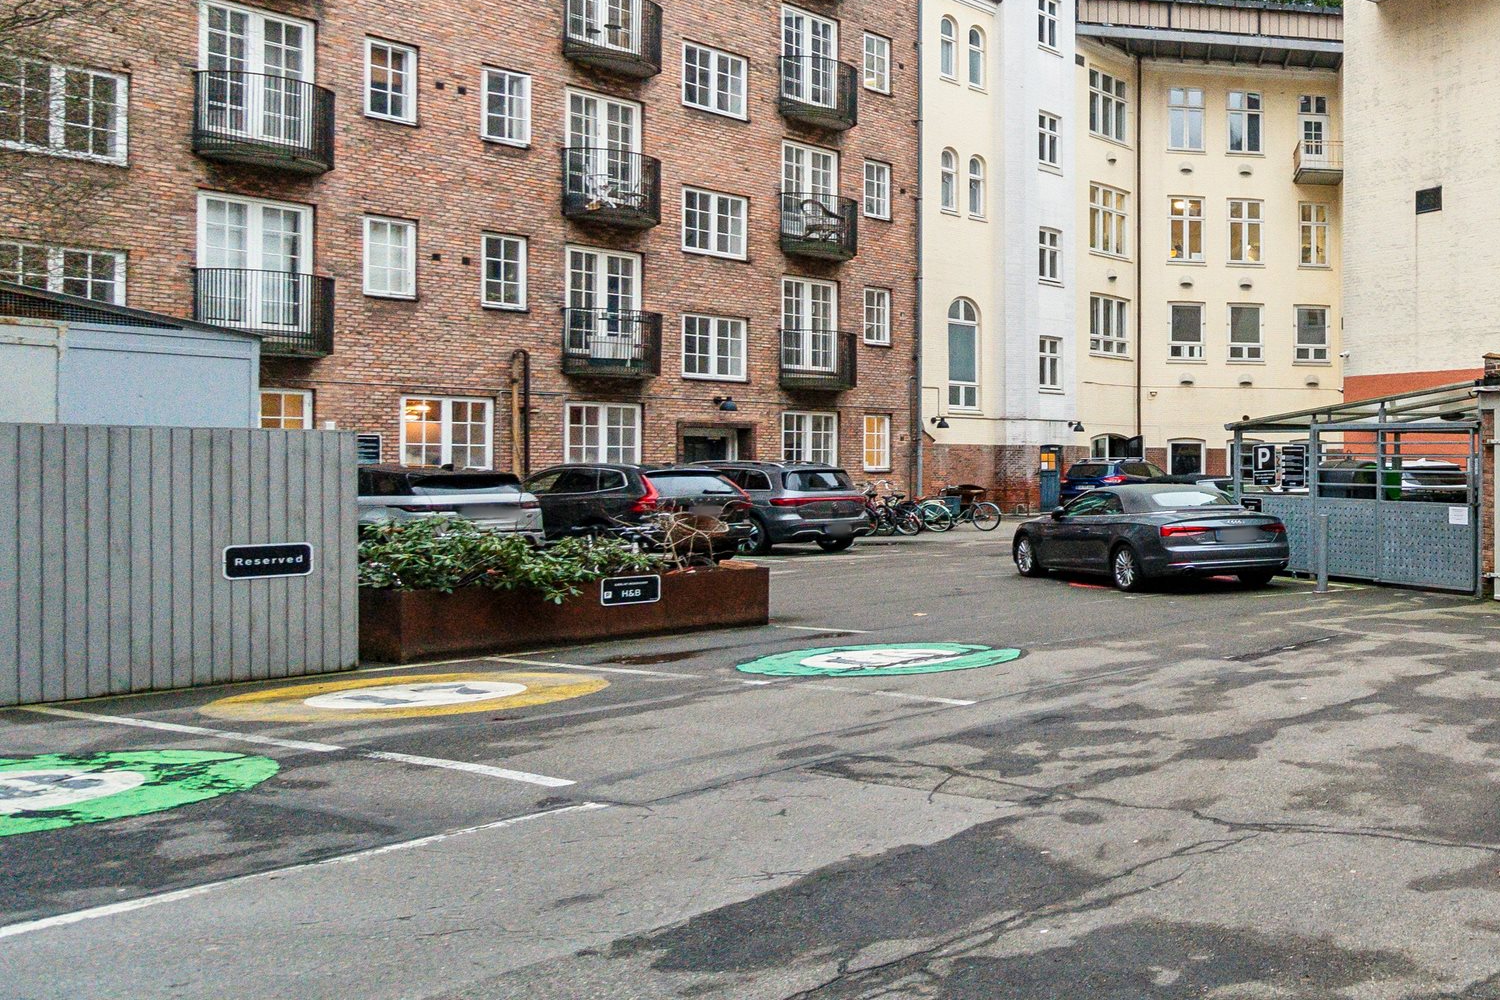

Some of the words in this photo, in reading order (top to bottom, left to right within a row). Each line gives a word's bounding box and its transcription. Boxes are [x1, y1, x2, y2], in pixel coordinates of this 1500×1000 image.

[1258, 448, 1271, 469] P
[234, 555, 304, 566] Reserved
[621, 589, 641, 598] H&B
